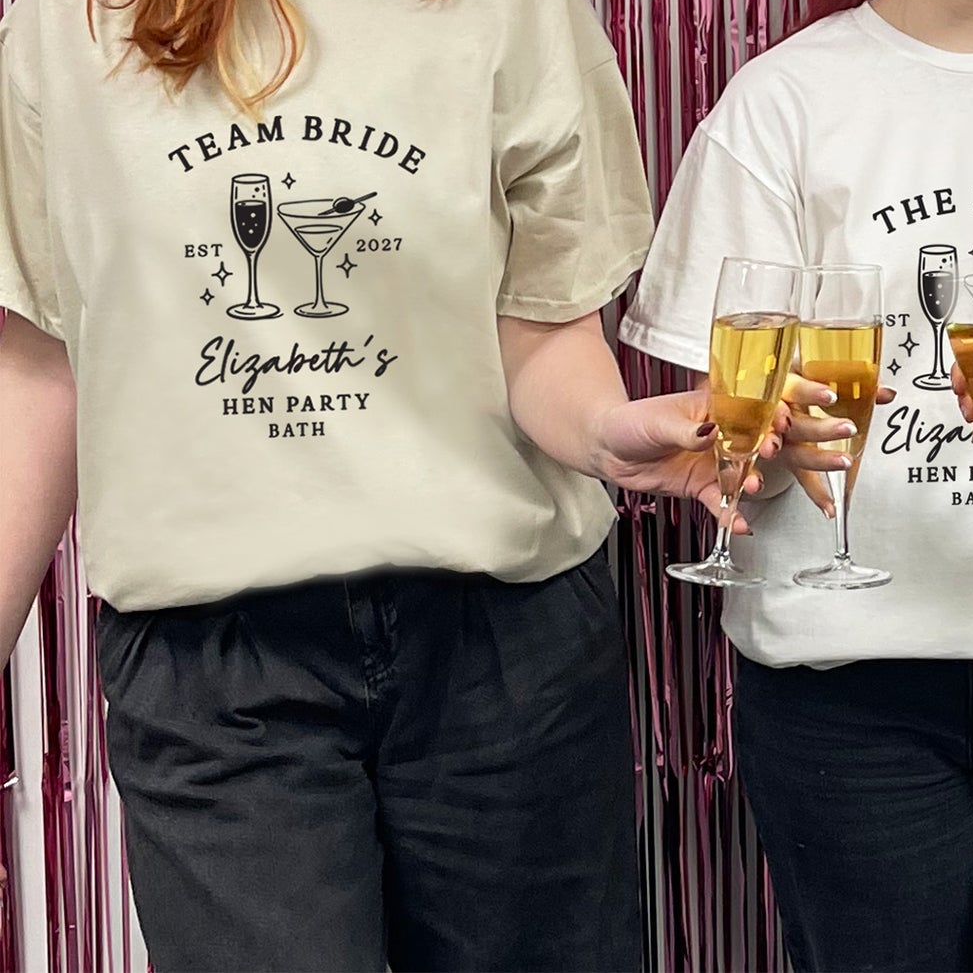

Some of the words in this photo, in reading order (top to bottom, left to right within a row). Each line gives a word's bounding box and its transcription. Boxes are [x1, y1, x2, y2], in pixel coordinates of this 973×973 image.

[168, 115, 285, 173] TEAM
[301, 115, 426, 175] BRIDE
[872, 188, 956, 234] THE
[184, 243, 223, 258] EST
[356, 237, 403, 253] 2027
[195, 334, 399, 394] Elizabeth's
[222, 396, 275, 416] HEN
[286, 392, 370, 413] PARTY
[268, 421, 325, 439] BATH
[907, 465, 958, 484] HEN
